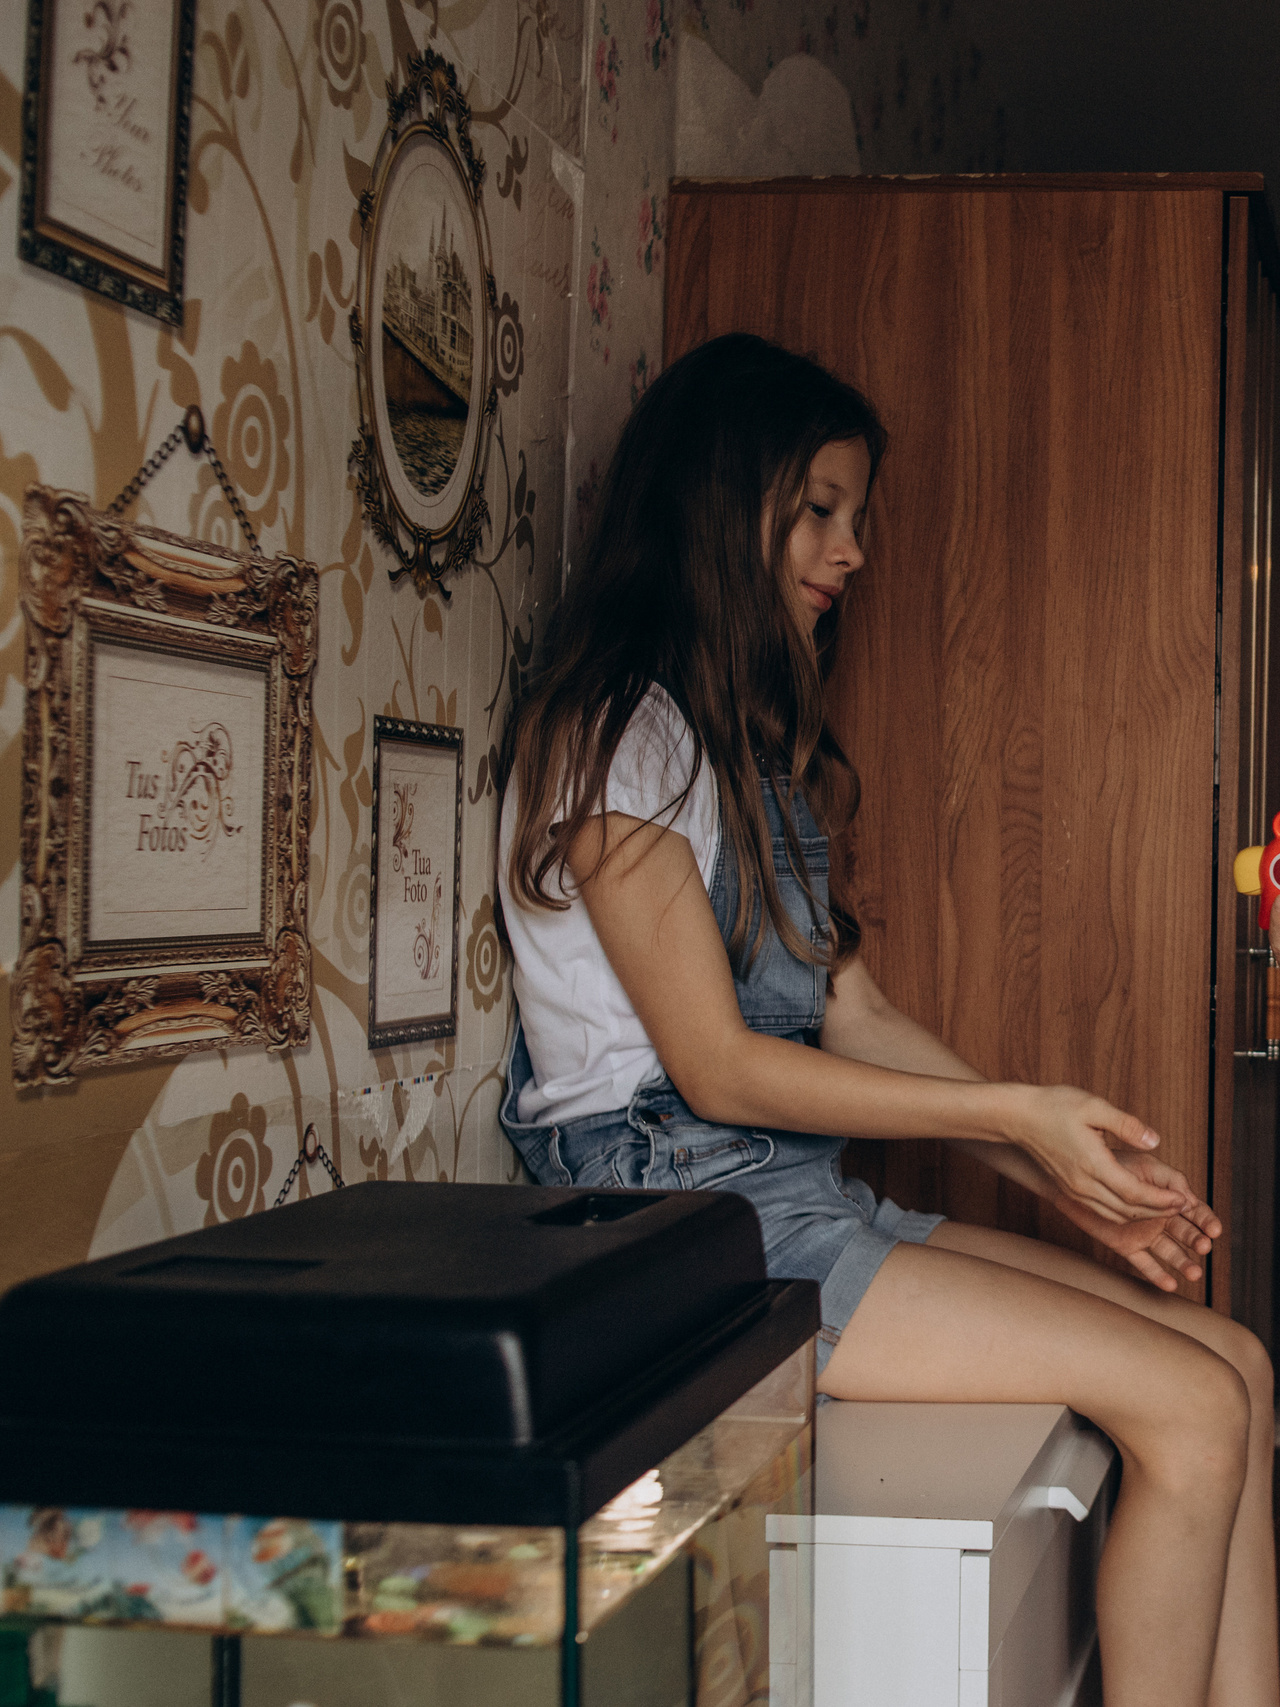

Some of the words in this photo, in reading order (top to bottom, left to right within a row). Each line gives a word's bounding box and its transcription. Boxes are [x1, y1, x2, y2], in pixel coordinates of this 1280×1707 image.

[107, 92, 151, 144] Your
[125, 760, 160, 799] Tus
[136, 813, 189, 851] Fotos
[411, 848, 431, 875] Tua
[403, 875, 428, 903] Foto
